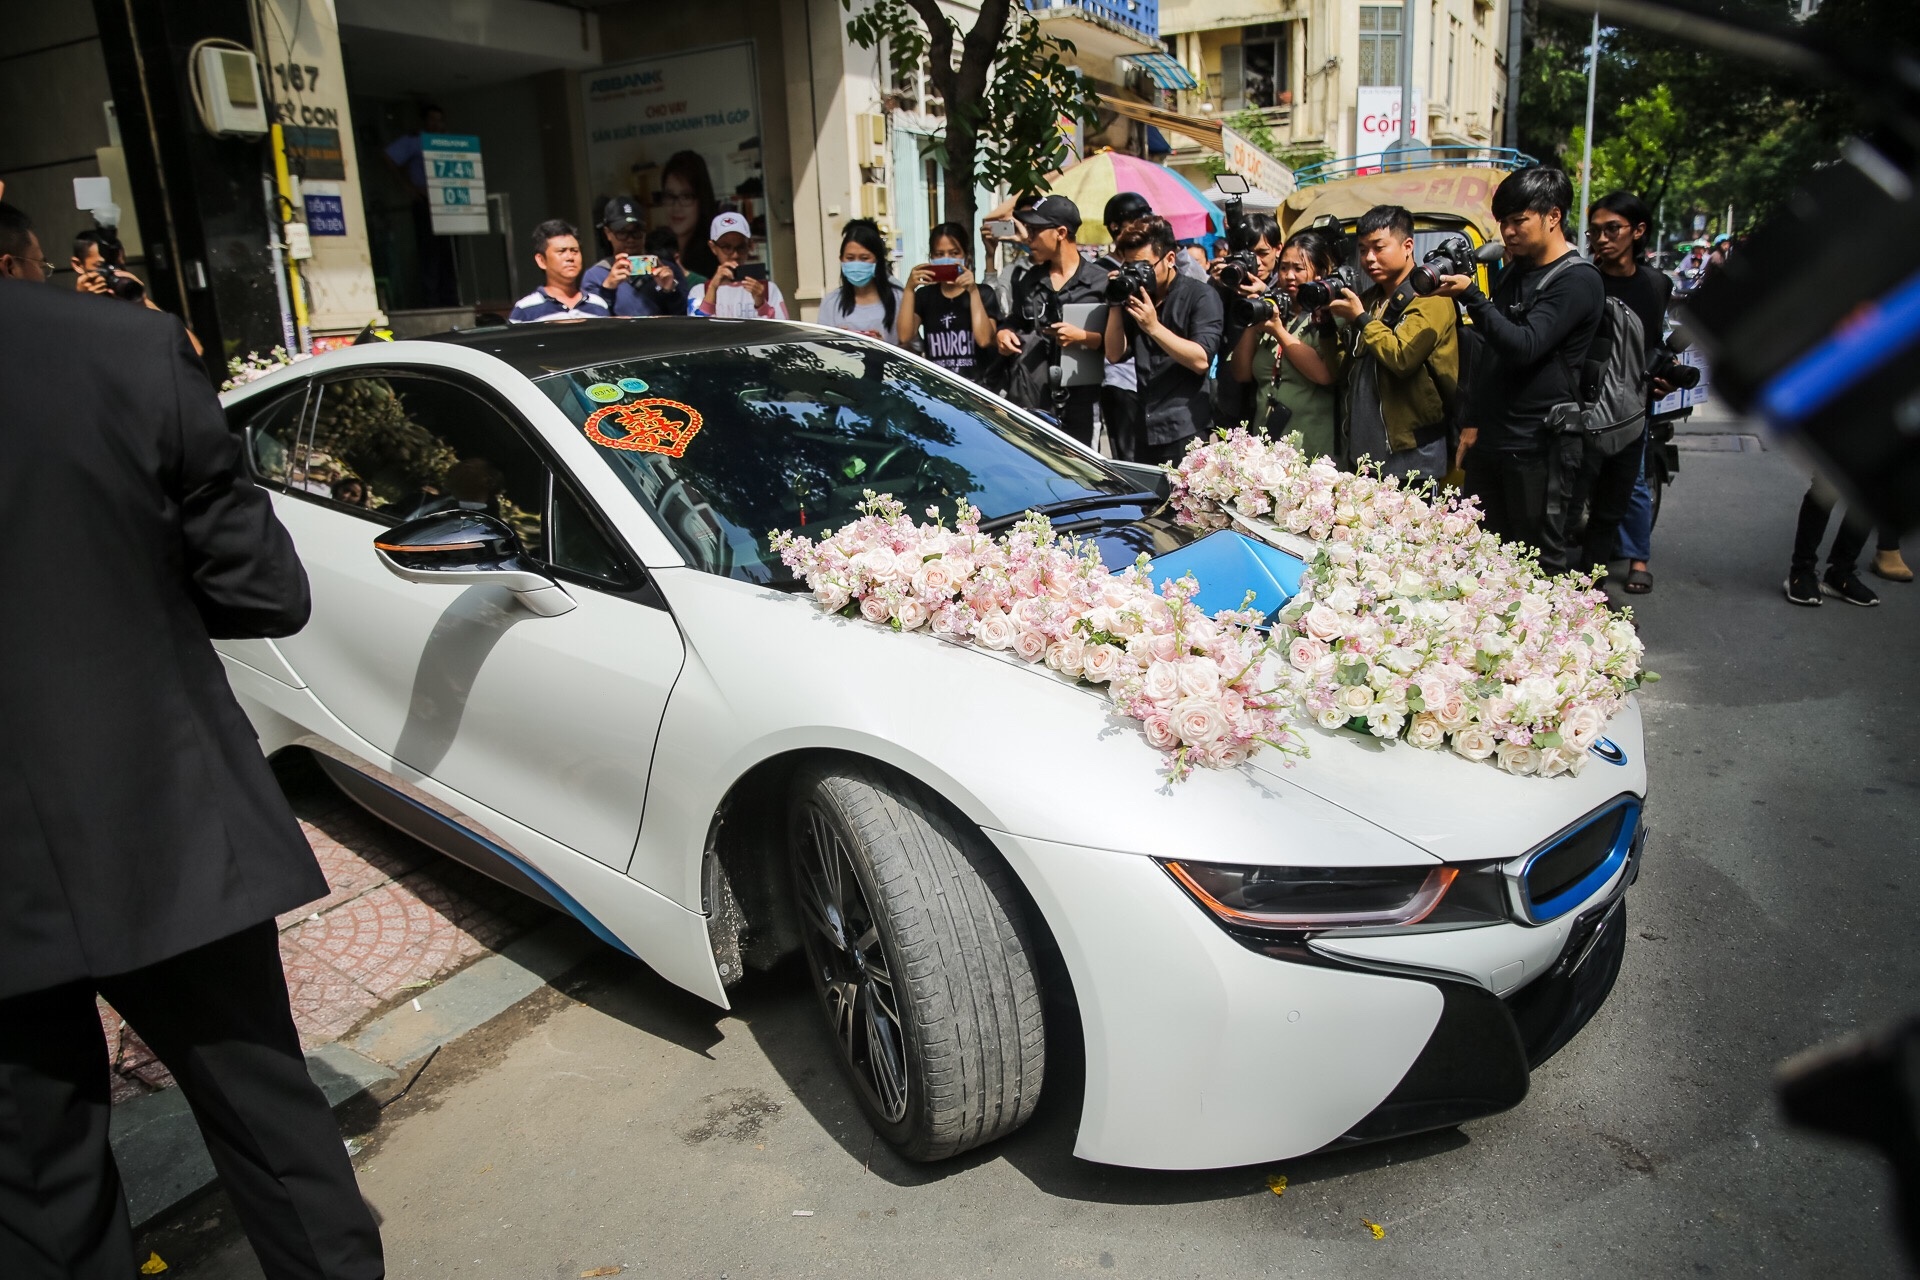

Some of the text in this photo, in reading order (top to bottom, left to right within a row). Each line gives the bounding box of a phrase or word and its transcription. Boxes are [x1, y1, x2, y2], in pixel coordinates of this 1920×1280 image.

[274, 63, 319, 92] 167
[301, 105, 338, 126] CON
[645, 101, 686, 118] CHO VAY
[664, 115, 703, 133] DOANH
[703, 109, 724, 127] TRẢ
[726, 108, 749, 124] GÓP
